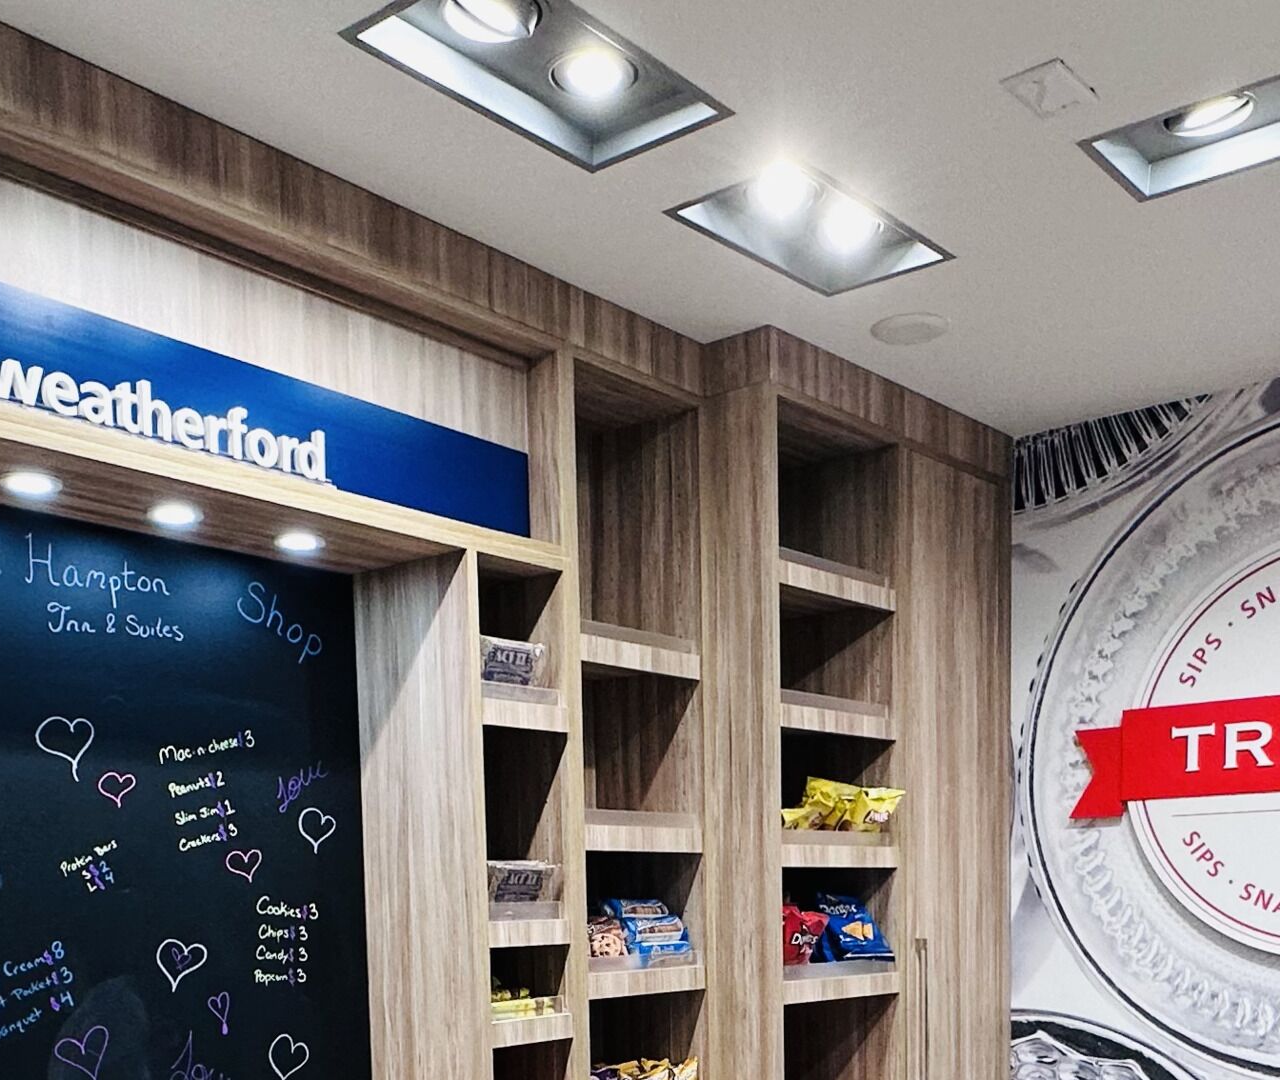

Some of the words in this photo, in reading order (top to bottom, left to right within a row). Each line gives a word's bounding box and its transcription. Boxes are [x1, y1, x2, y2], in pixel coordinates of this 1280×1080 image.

[25, 532, 170, 608] Hampton
[47, 601, 96, 634] Inn
[106, 614, 116, 633] &
[125, 614, 184, 641] Suites
[236, 582, 322, 664] Shop
[1179, 633, 1223, 688] SIPS
[174, 811, 197, 825] Slim
[1182, 829, 1225, 879] SIPS
[256, 895, 301, 918] Cookies
[258, 924, 289, 943] Chips
[3, 957, 46, 977] Cream
[256, 945, 289, 964] Candy
